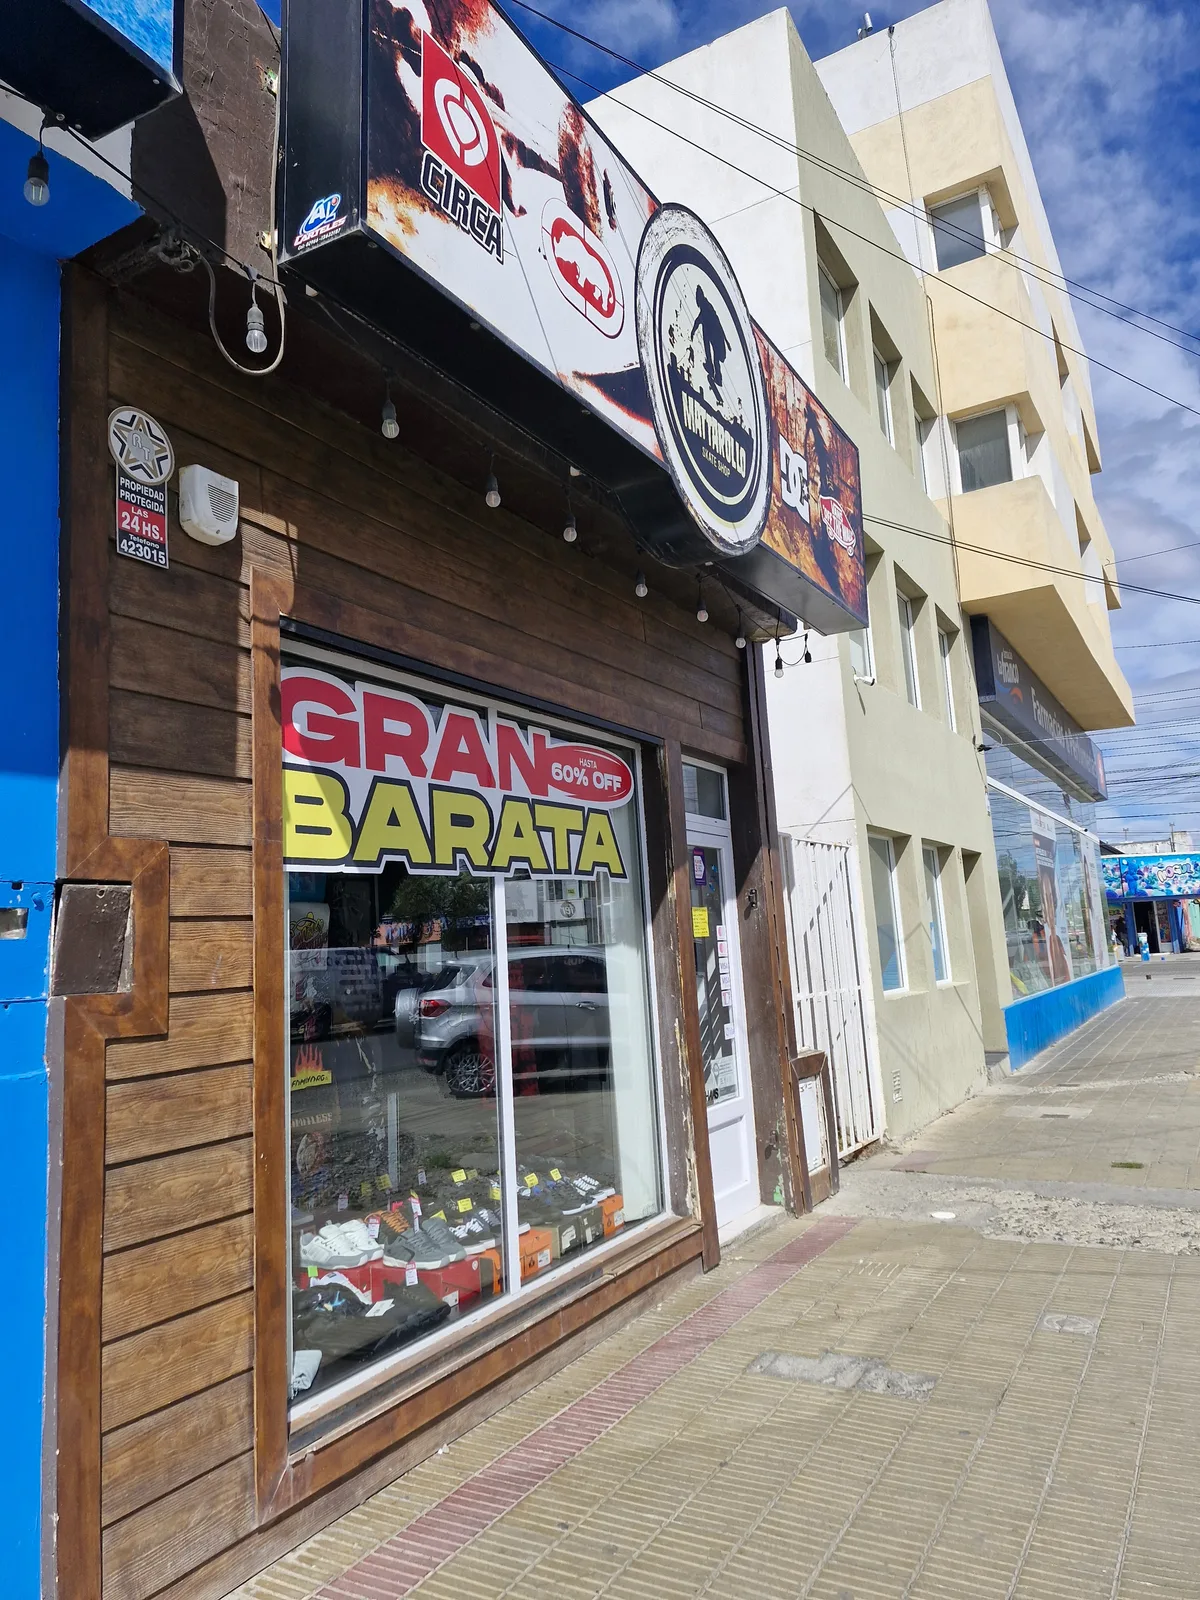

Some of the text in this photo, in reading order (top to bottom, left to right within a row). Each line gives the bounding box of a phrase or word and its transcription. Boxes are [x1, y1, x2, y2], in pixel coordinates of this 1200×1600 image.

[294, 215, 347, 246] CARTELES
[681, 390, 747, 479] MATTAROLLO
[702, 446, 731, 478] SKATE SHOP
[120, 476, 165, 502] PROPIEDAD
[120, 489, 165, 514] PROTEGIDA
[121, 511, 164, 542] 24 HS.
[131, 506, 149, 519] LAS
[120, 538, 166, 565] 423015
[281, 675, 550, 798] GRAN
[551, 762, 622, 793] 60% OFF
[579, 757, 598, 770] HASTA
[282, 766, 626, 877] BARATA
